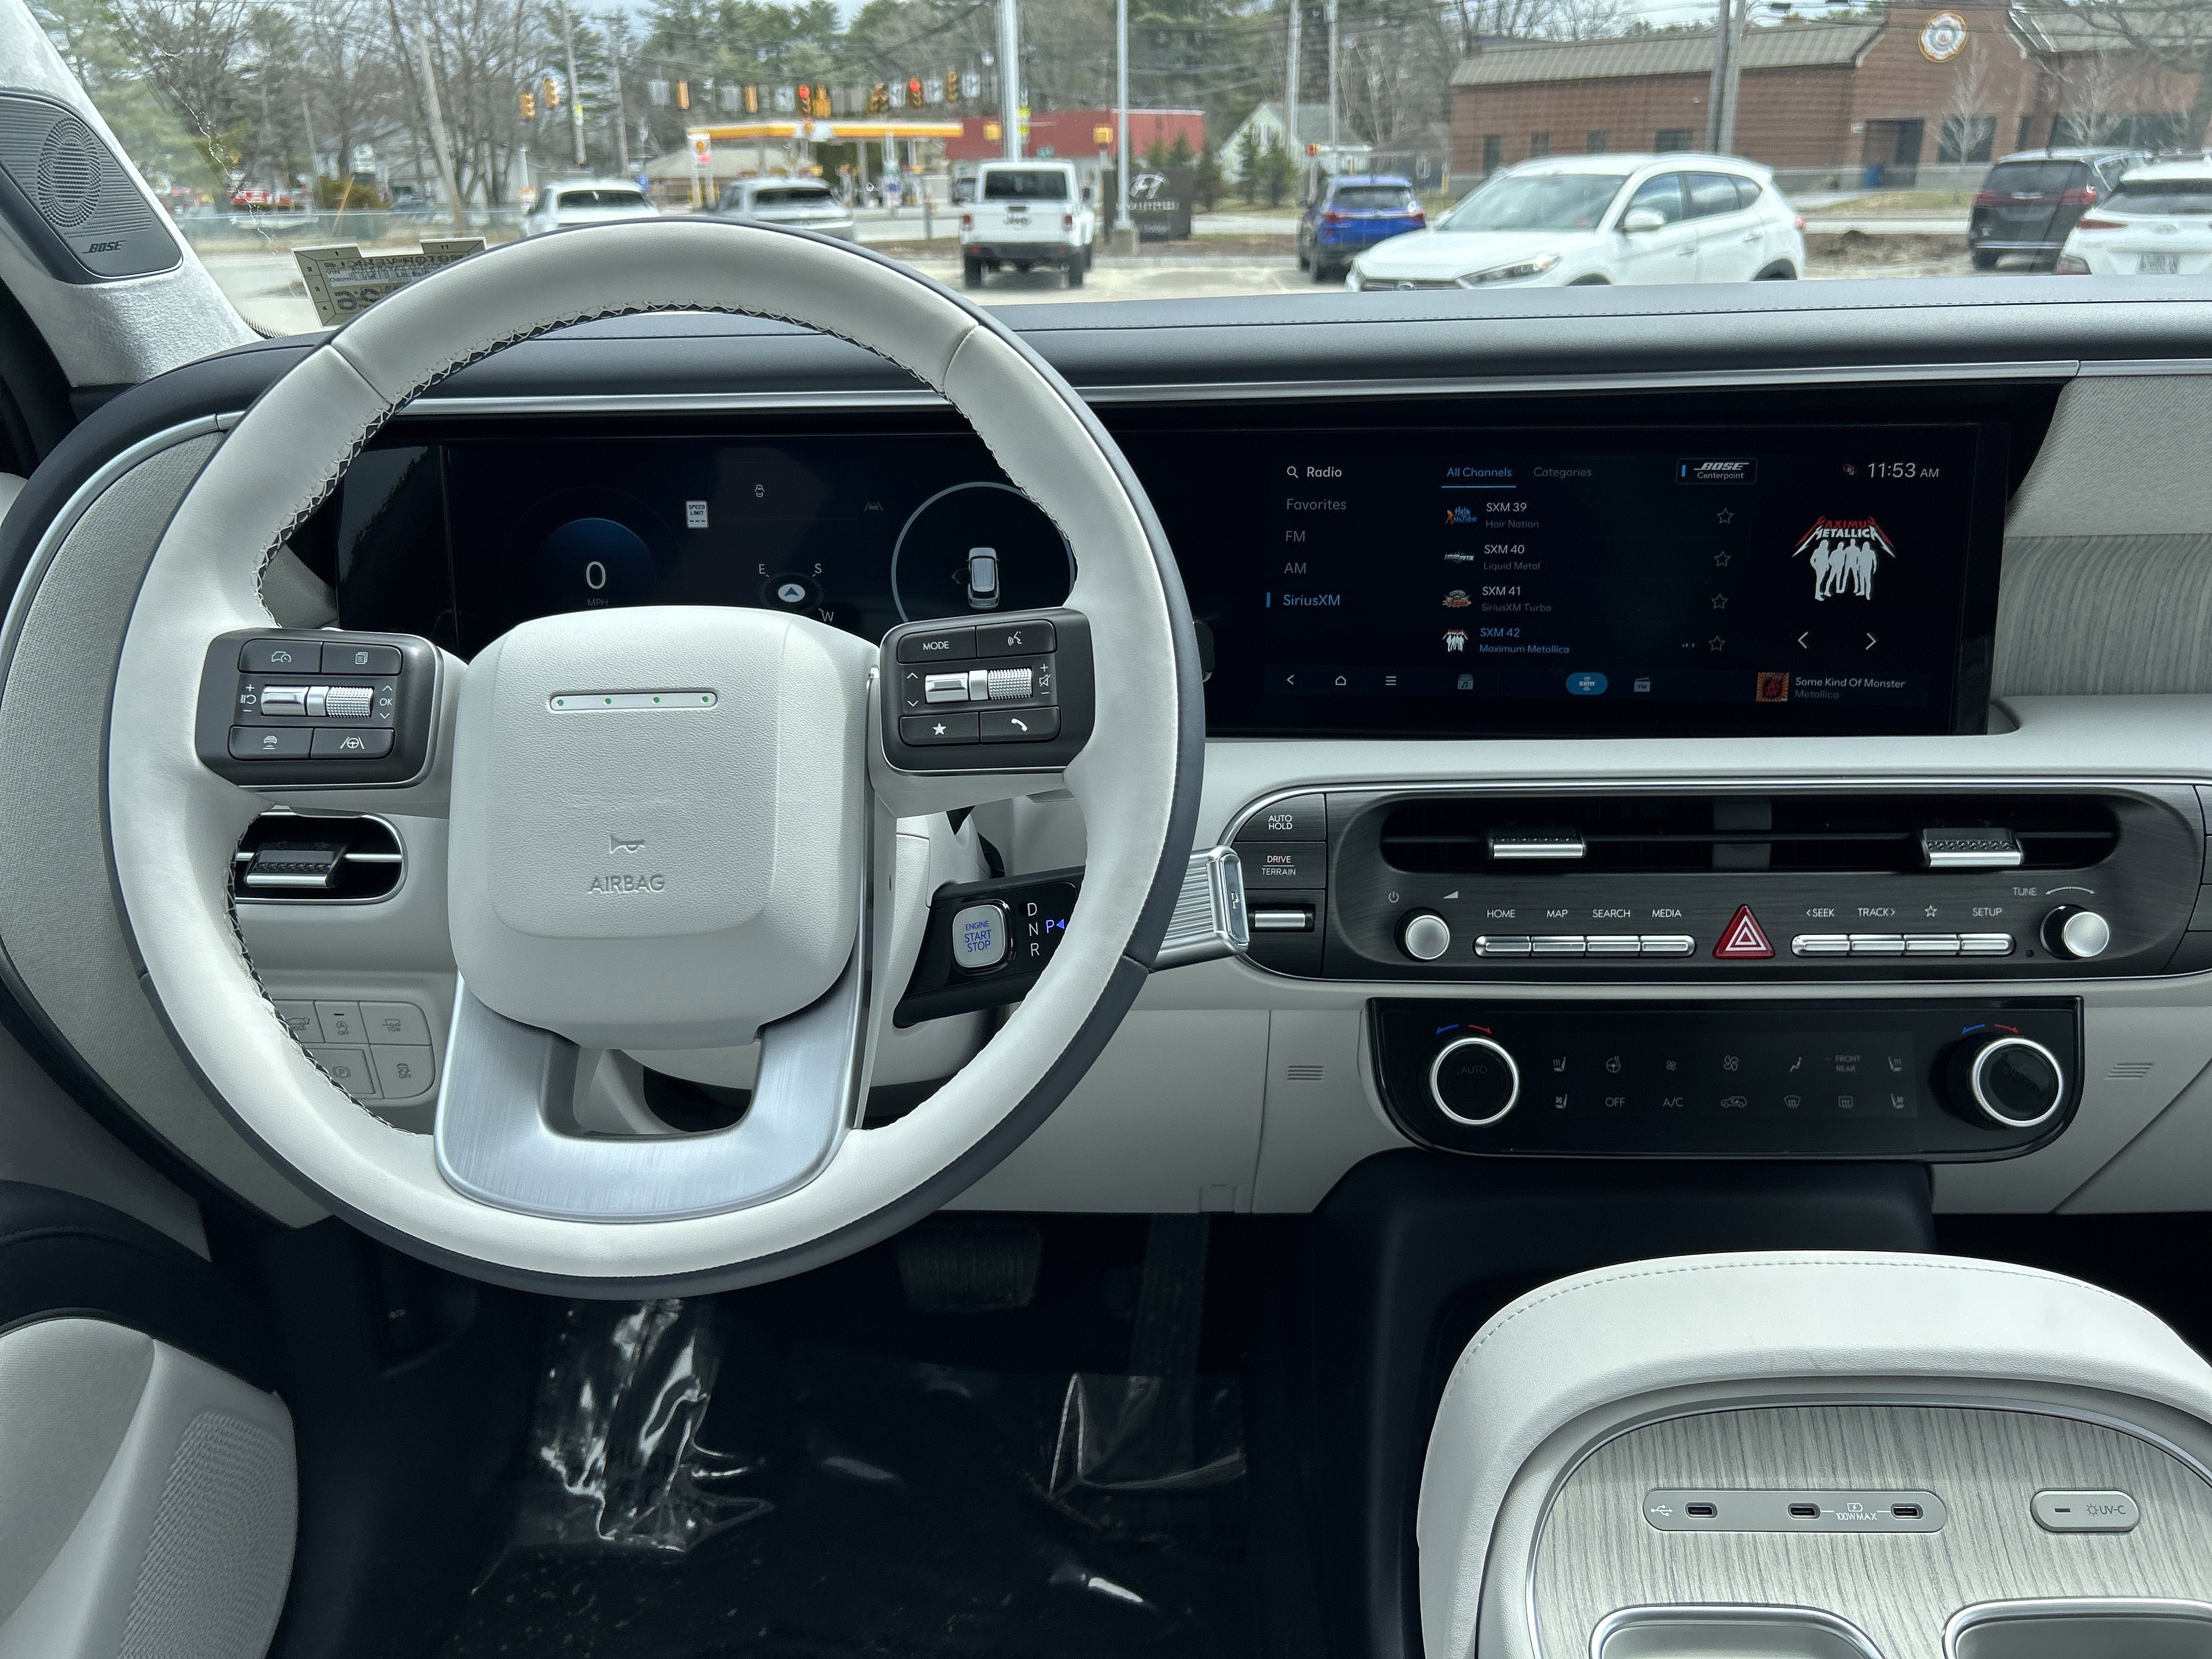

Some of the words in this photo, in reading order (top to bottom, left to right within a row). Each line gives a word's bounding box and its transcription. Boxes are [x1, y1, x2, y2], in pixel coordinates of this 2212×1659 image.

[82, 240, 126, 253] BOSE
[1694, 462, 1749, 470] BOSE
[1868, 462, 1916, 478] 11:53
[1307, 466, 1342, 477] Radio
[1447, 467, 1460, 477] All
[1463, 467, 1512, 477] Channels
[1533, 467, 1592, 479] Categories
[1697, 471, 1744, 480] Centerpoint
[1920, 468, 1939, 478] AM
[1286, 498, 1347, 510] Favorites
[1486, 502, 1509, 512] SXM
[1513, 502, 1527, 512] 39
[1486, 520, 1505, 528] Hair
[1508, 520, 1539, 528] Nation
[1285, 531, 1306, 542] FM
[1484, 544, 1508, 554] SXM
[1510, 544, 1525, 554] 40
[759, 563, 766, 574] E
[814, 563, 822, 574] S
[1284, 562, 1307, 574] AM
[1483, 562, 1511, 572] Liquid
[1514, 562, 1541, 570] Metal
[586, 561, 606, 590] 0
[1482, 586, 1505, 596] SXM
[1508, 586, 1521, 596] 41
[1283, 594, 1341, 606] SiriusXM
[1481, 603, 1521, 612] SiriusXM
[1524, 603, 1552, 612] Turbo
[822, 611, 834, 622] W
[1480, 628, 1504, 637] SXM
[1506, 628, 1520, 637] 42
[923, 641, 950, 651] MODE
[1479, 645, 1525, 653] Maximum
[1527, 645, 1570, 654] Metallica
[1795, 676, 1822, 686] Some
[1825, 678, 1847, 687] Kind
[1849, 678, 1861, 687] Of
[1864, 679, 1905, 689] Monster
[1795, 690, 1839, 699] Metallica
[379, 698, 393, 707] OK
[588, 874, 665, 894] AIRBAG
[2012, 887, 2036, 896] TUNE
[1027, 902, 1037, 917] D
[1486, 910, 1515, 918] HOME
[1546, 909, 1568, 918] MAP
[1592, 909, 1630, 918] SEARCH
[1651, 909, 1681, 918] MEDIA
[1972, 907, 2002, 917] SETUP
[966, 920, 989, 931] ENGINE
[1029, 922, 1039, 936] N
[1046, 919, 1054, 934] P
[964, 929, 991, 943] START
[967, 940, 991, 952] STOP
[1030, 943, 1040, 957] R
[1835, 1054, 1860, 1063] FRONT
[1461, 1065, 1487, 1074] AUTO
[1836, 1064, 1856, 1073] REAR
[1605, 1097, 1625, 1108] OFF
[1662, 1097, 1684, 1108] A/C
[2099, 1505, 2126, 1515] UV-C
